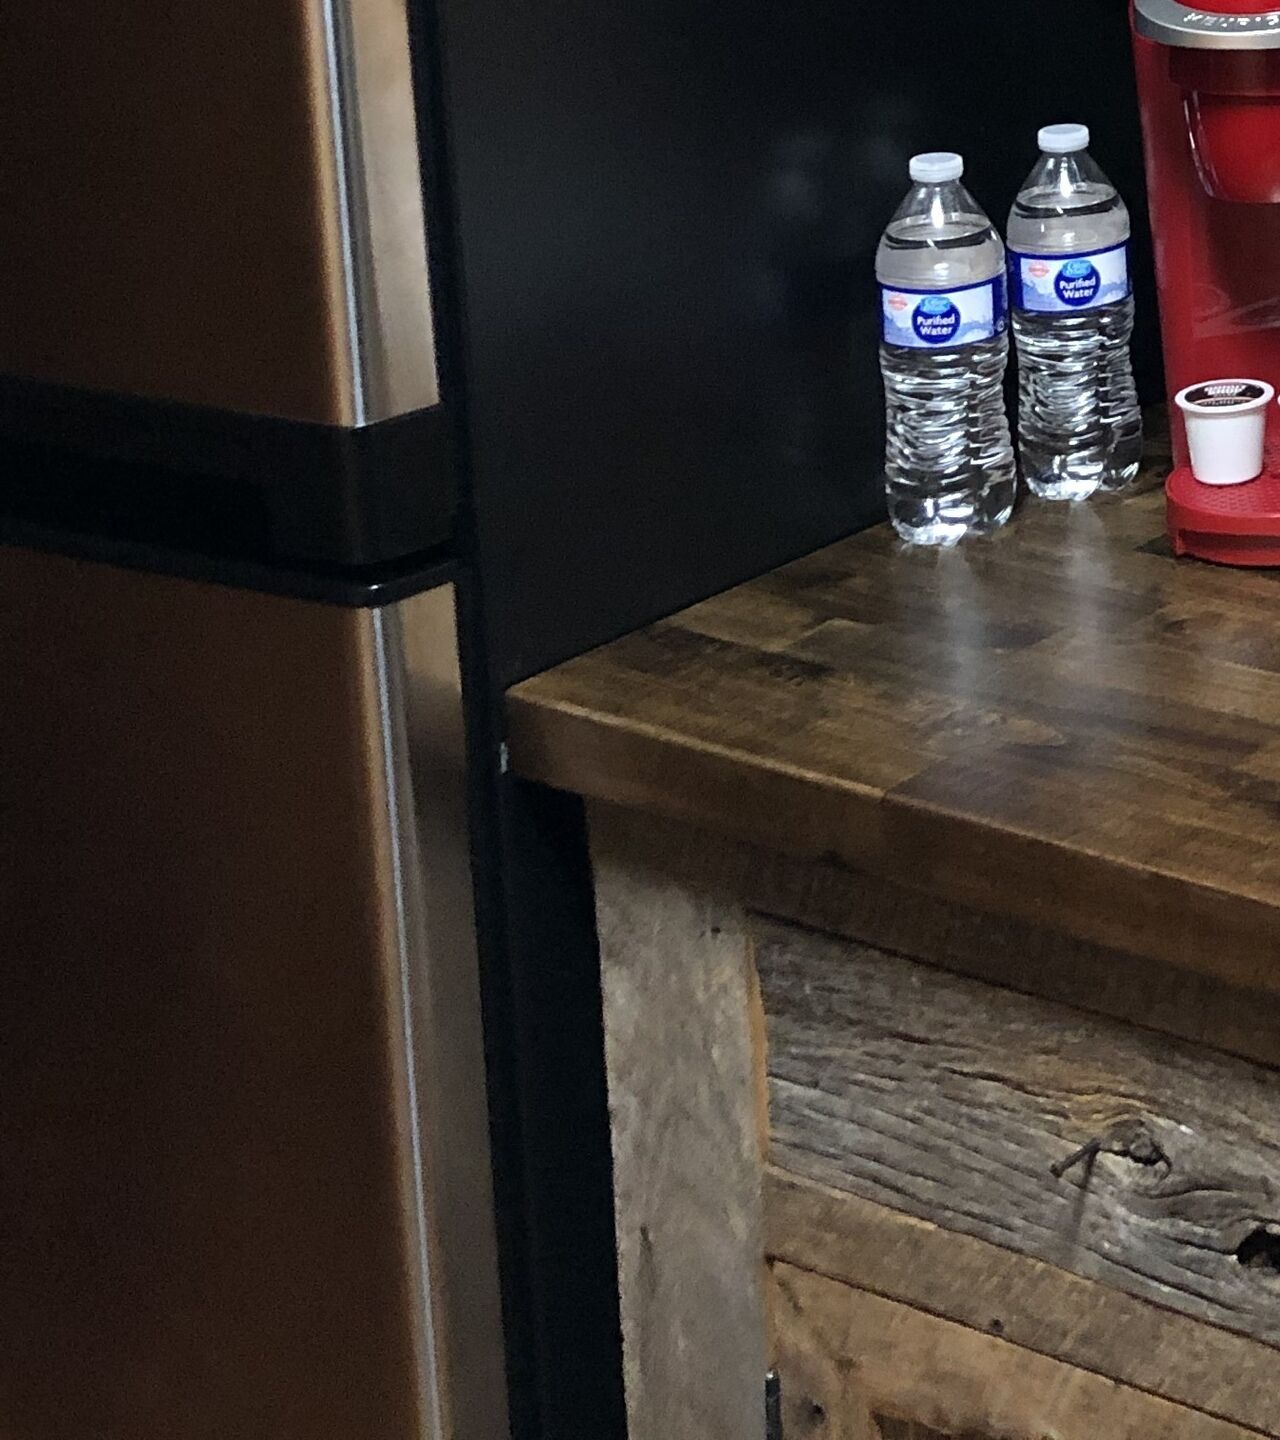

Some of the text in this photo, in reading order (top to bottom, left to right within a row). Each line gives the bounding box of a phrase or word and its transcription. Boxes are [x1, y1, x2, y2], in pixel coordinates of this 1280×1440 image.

[1059, 276, 1096, 290] Purified
[1062, 288, 1094, 299] Water
[916, 314, 956, 326] Purified
[920, 326, 953, 336] Water
